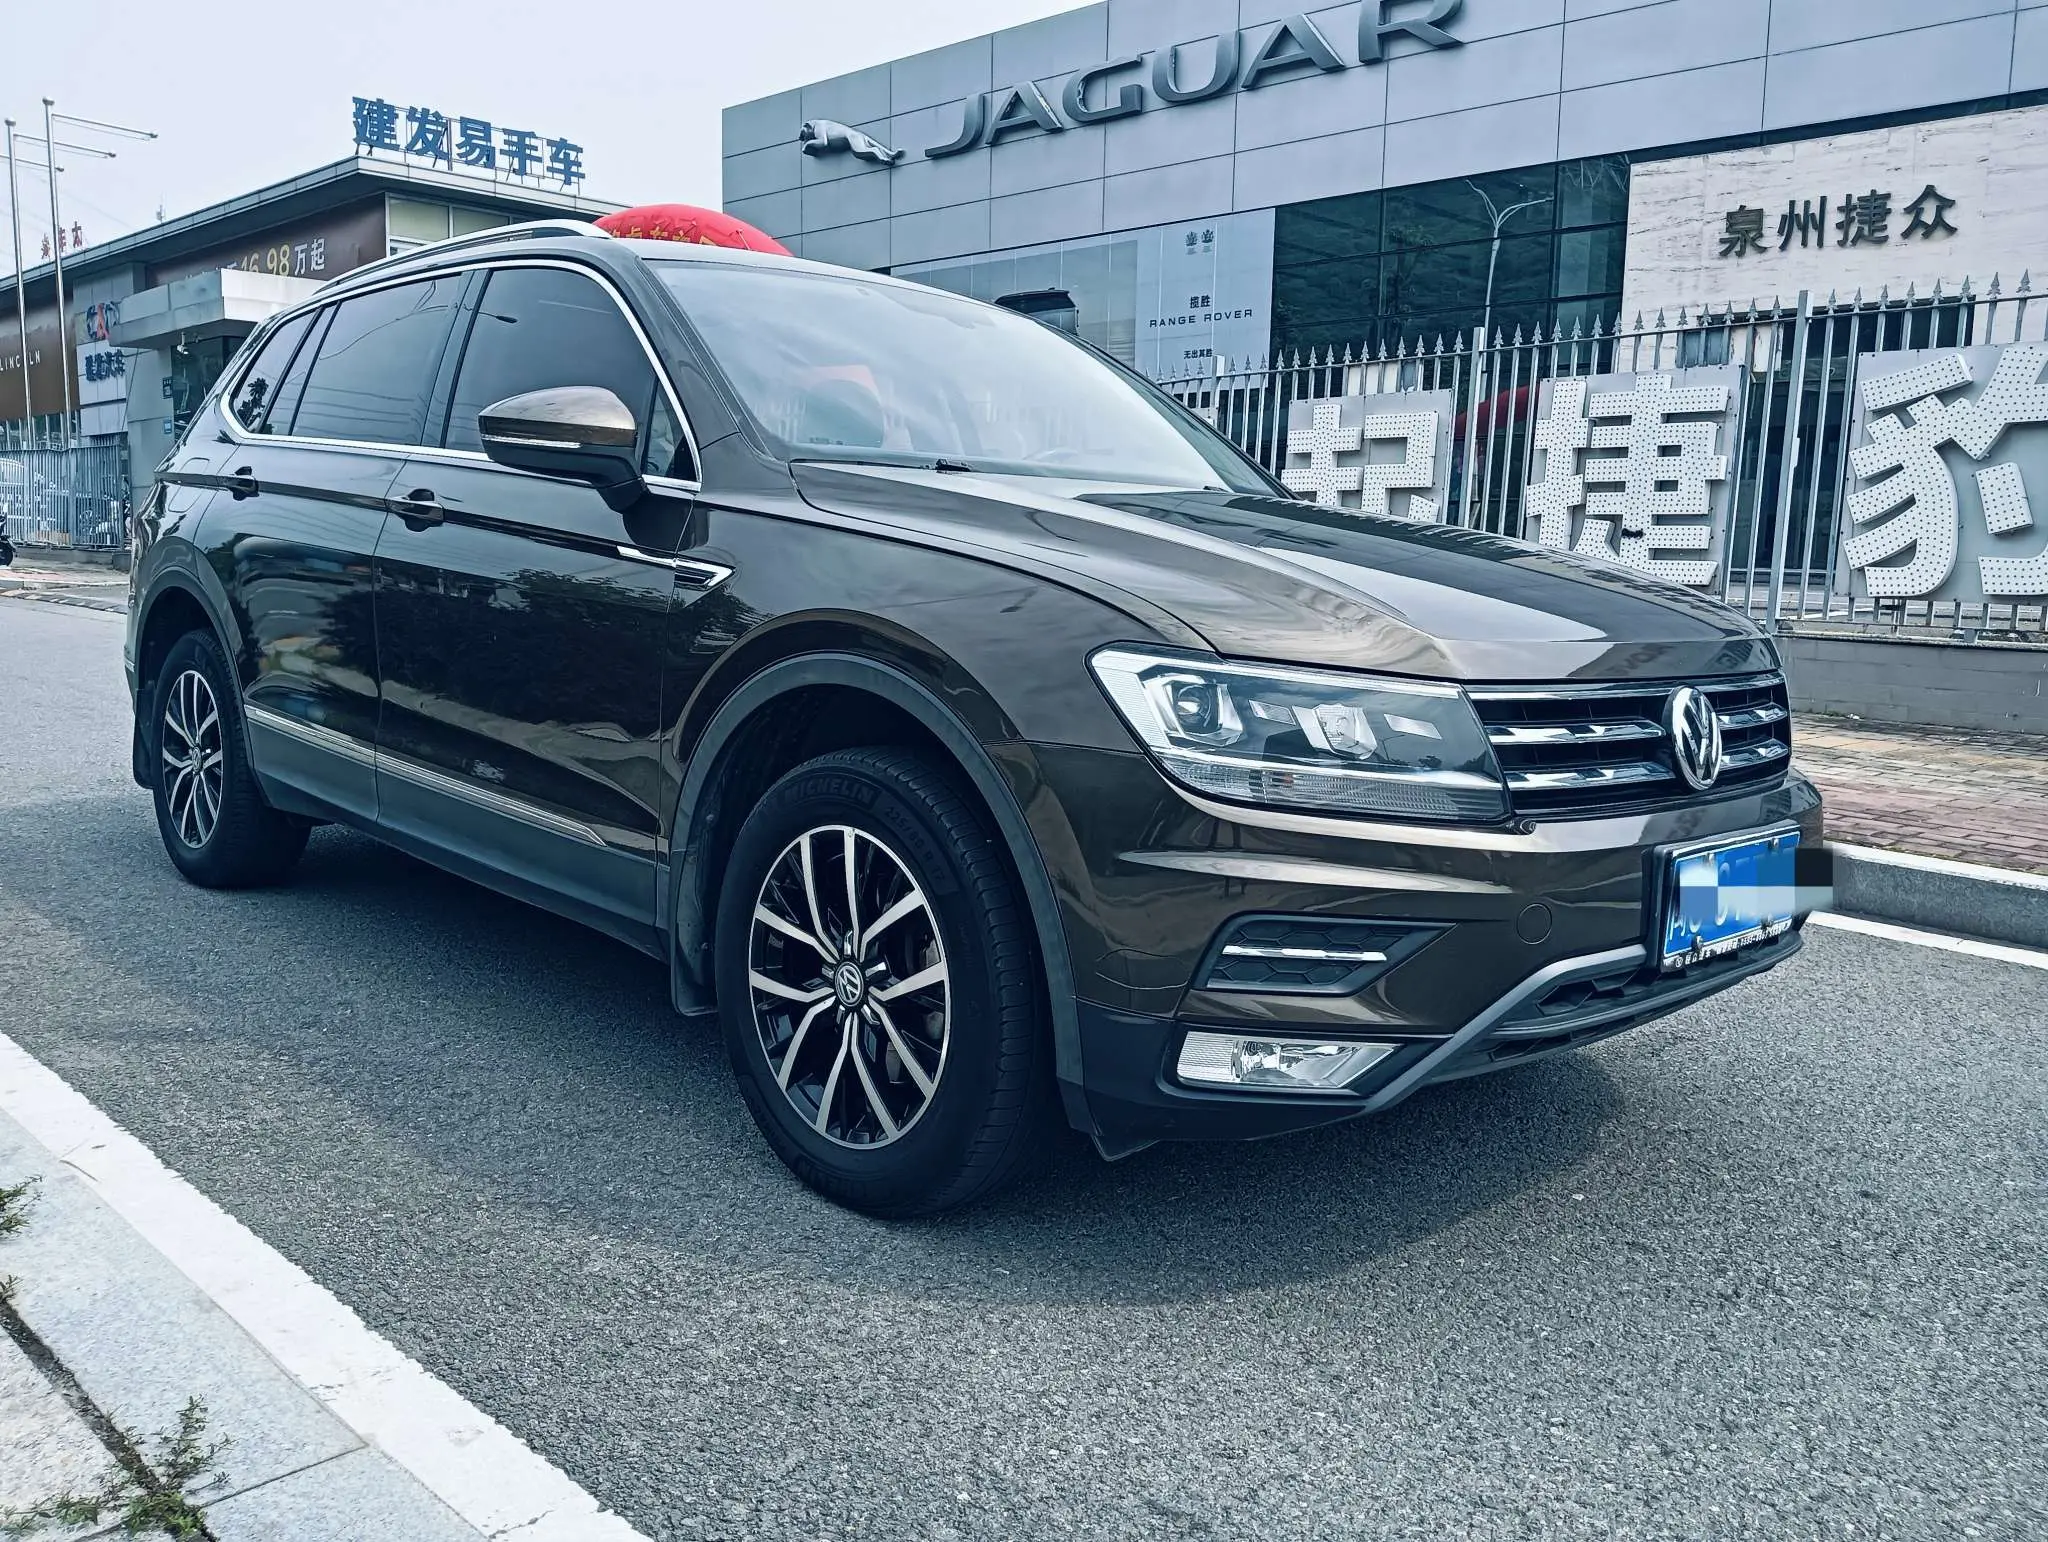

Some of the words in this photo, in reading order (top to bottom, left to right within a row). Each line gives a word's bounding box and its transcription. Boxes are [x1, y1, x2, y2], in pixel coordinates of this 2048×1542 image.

[925, 0, 1464, 159] JAGUAR
[352, 96, 586, 186] 建发易手车
[1718, 184, 1958, 258] 泉州捷众
[1149, 315, 1197, 328] RANGE
[1203, 309, 1253, 322] ROVER
[0, 350, 41, 372] LINCLN
